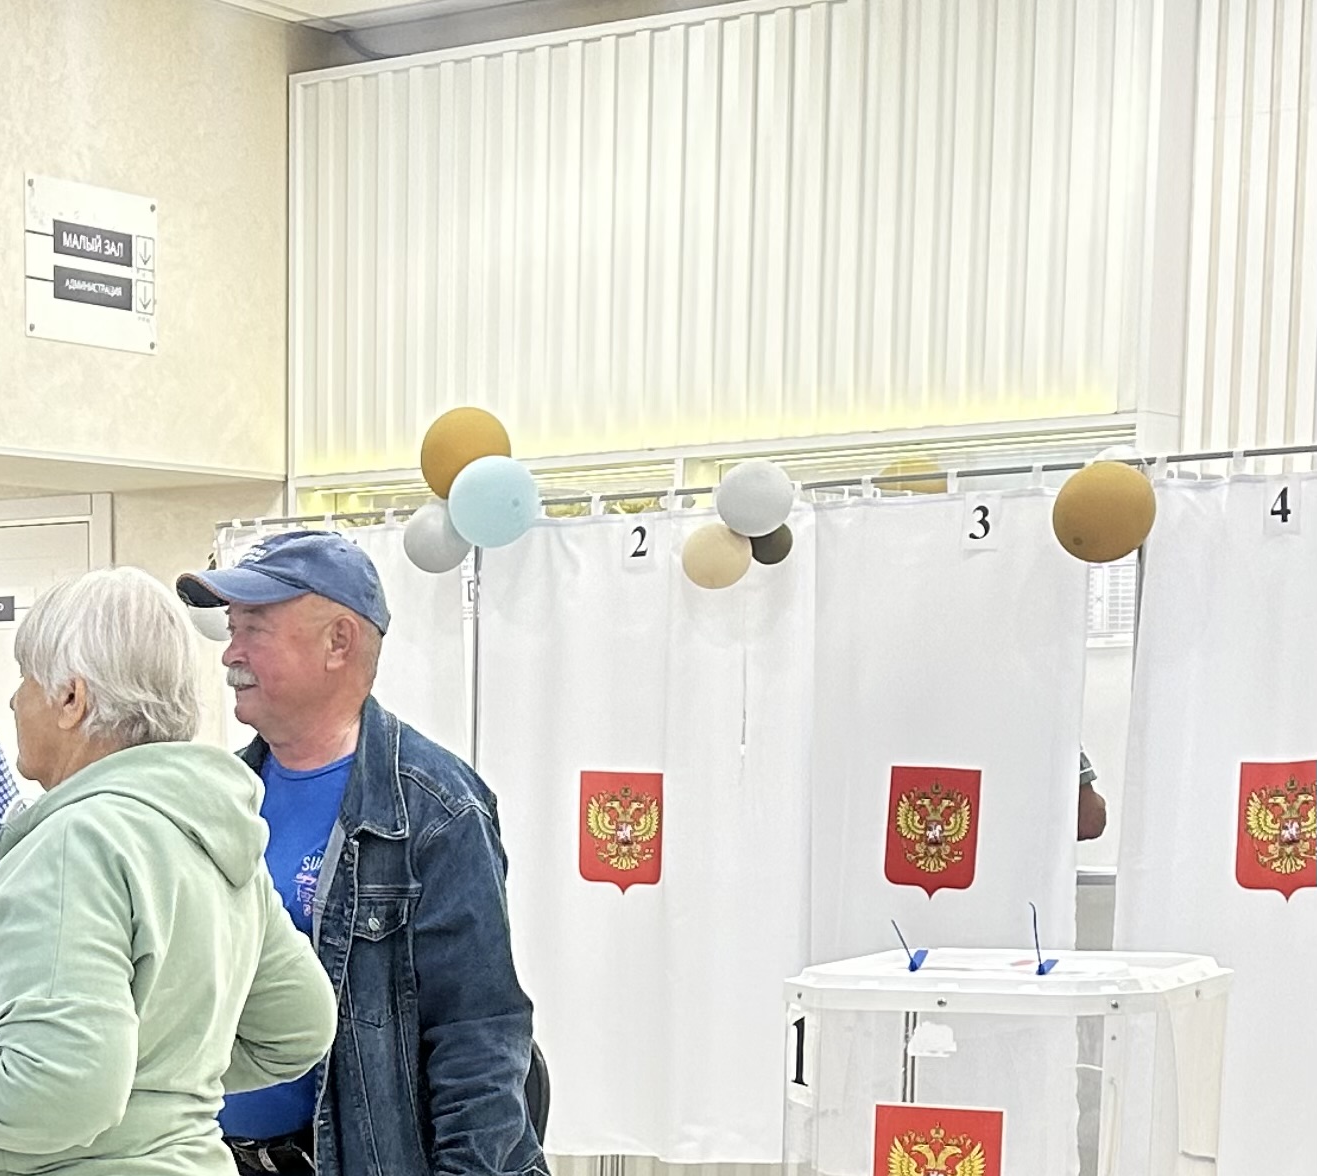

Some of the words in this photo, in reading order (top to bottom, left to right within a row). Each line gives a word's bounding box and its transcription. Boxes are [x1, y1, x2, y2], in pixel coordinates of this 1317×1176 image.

[62, 231, 102, 254] МАЛЫЙ
[103, 239, 124, 258] ЗАЛ
[64, 278, 122, 298] АДМИНИСТРАЦИЯ
[1270, 486, 1292, 523] 4
[968, 505, 990, 540] 3
[629, 525, 649, 558] 2
[790, 1016, 809, 1087] 1
